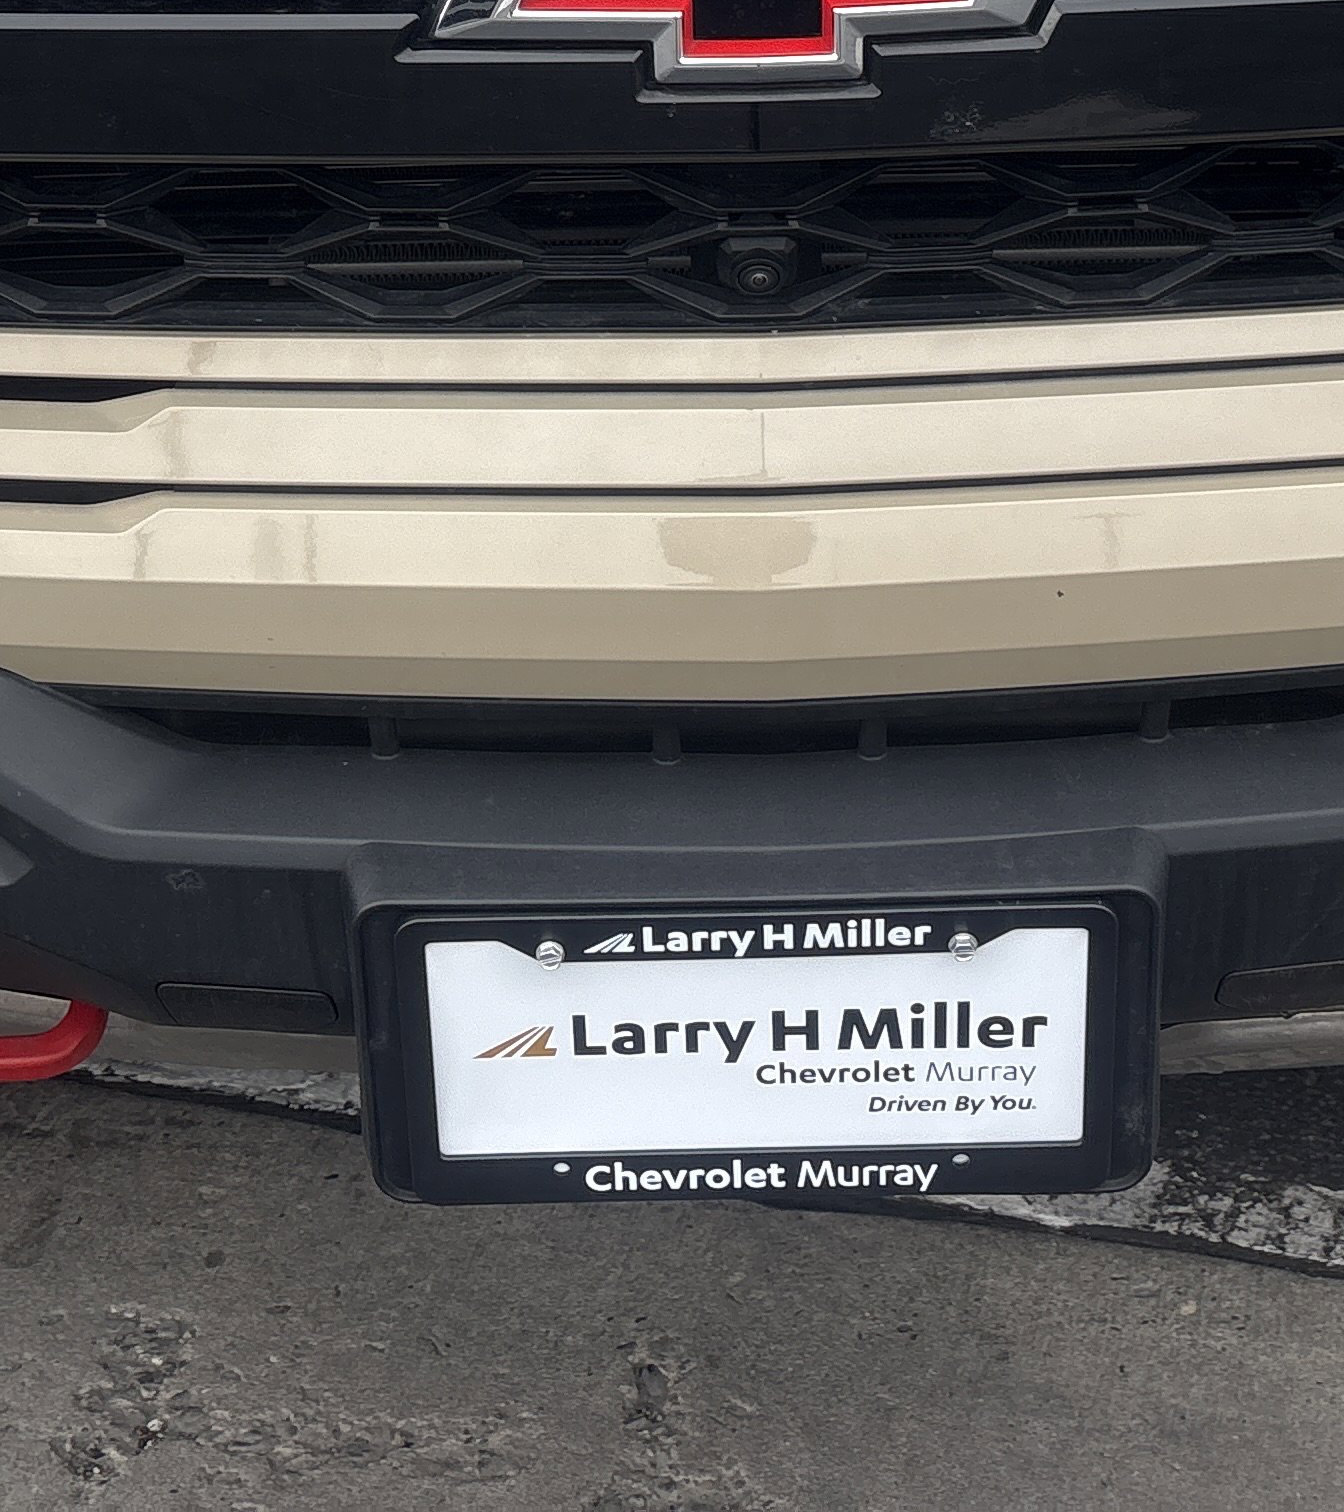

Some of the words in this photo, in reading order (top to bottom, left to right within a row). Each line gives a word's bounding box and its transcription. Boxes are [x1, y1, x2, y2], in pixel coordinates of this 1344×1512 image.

[641, 925, 756, 958] Larry
[763, 924, 796, 951] H
[804, 918, 932, 949] Miller
[571, 1012, 757, 1064] Larry
[771, 1010, 819, 1051] H
[837, 1000, 1048, 1050] Miller
[755, 1060, 915, 1086] Chevrolet
[925, 1060, 1037, 1087] Murray
[868, 1095, 947, 1114] Driven
[954, 1094, 985, 1117] By
[990, 1093, 1037, 1113] You.
[585, 1159, 787, 1192] Chevrolet
[796, 1160, 939, 1193] Murray
